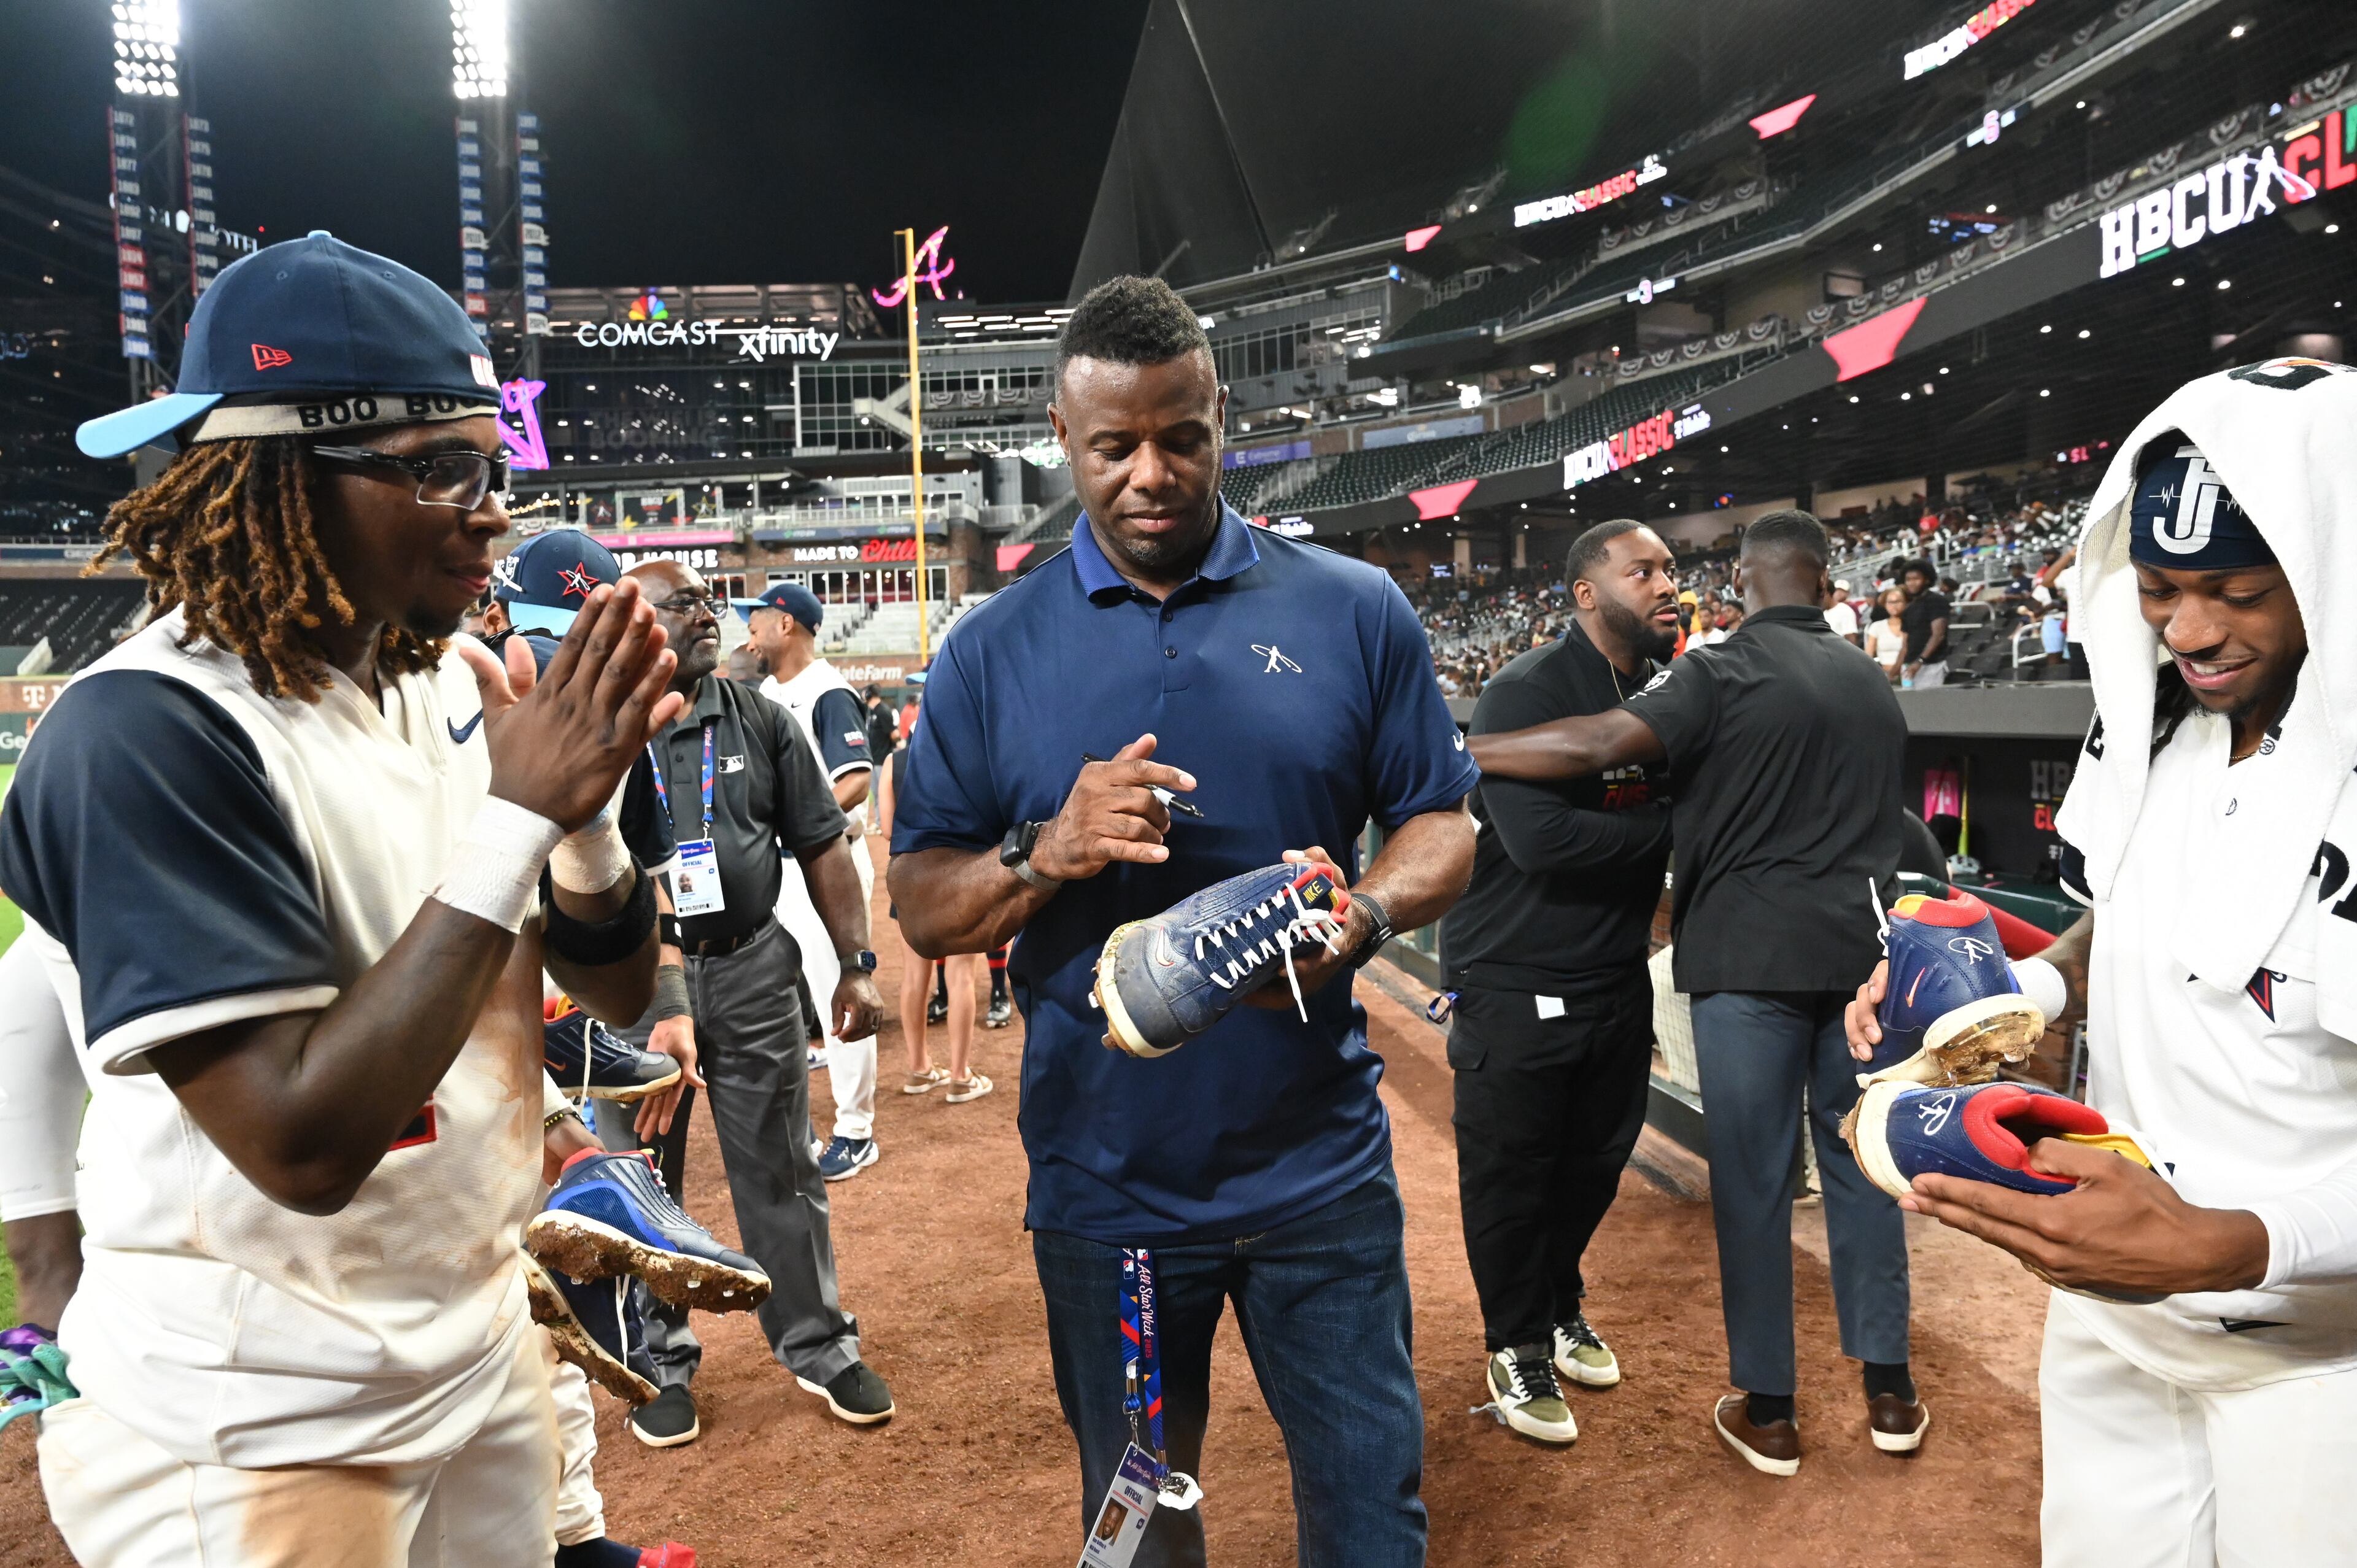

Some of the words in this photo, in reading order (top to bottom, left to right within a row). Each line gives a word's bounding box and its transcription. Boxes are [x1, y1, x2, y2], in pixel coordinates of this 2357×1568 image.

[2100, 153, 2249, 278] HBCU
[577, 322, 721, 347] COMCAST
[738, 325, 839, 363] xfinity
[296, 398, 378, 428] BOO
[1609, 409, 1674, 471] CLASSIC
[794, 546, 837, 562] MADE
[838, 546, 859, 560] TO
[2030, 759, 2072, 800] HB
[1302, 879, 1323, 904] NIKE
[1137, 1262, 1151, 1284] All
[1139, 1285, 1153, 1310] Star
[1141, 1309, 1155, 1338] Week
[1144, 1338, 1153, 1359] 2025
[1124, 1485, 1143, 1505] OFFICIAL
